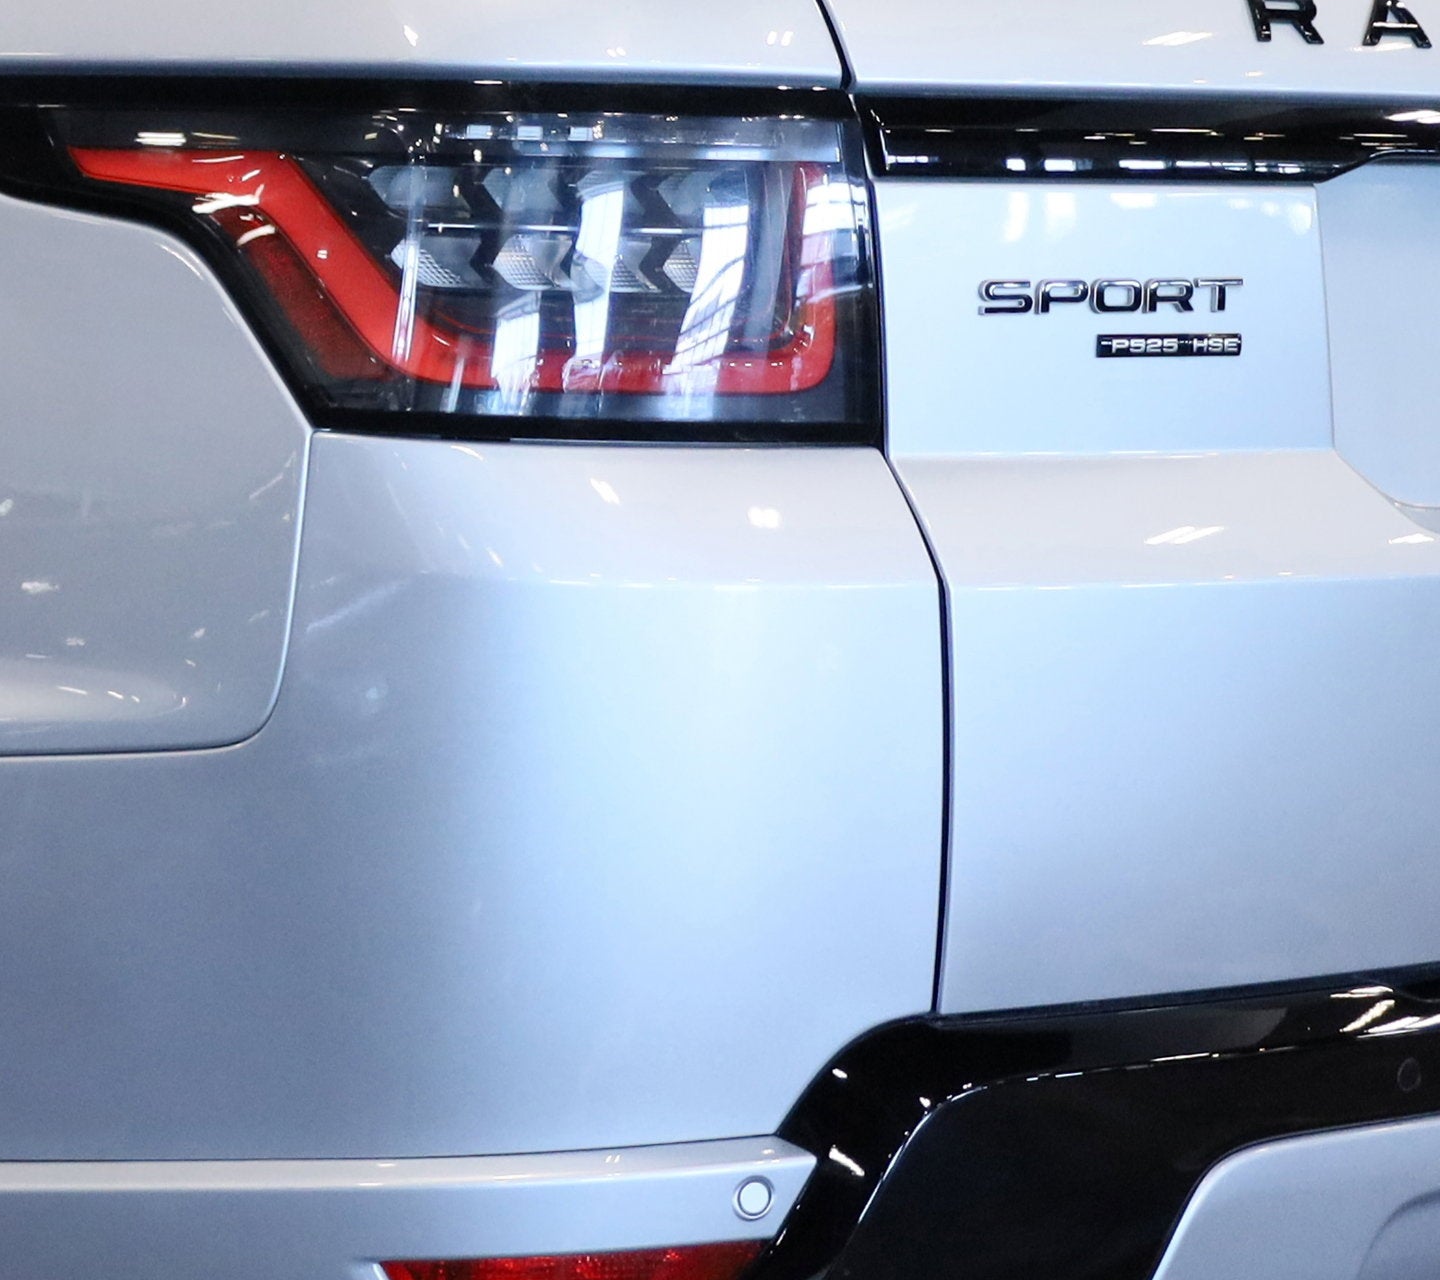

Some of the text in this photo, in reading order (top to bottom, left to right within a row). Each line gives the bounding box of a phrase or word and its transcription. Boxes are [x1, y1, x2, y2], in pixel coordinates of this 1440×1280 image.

[977, 277, 1244, 316] SPORT
[1111, 338, 1240, 354] P525 HSE
